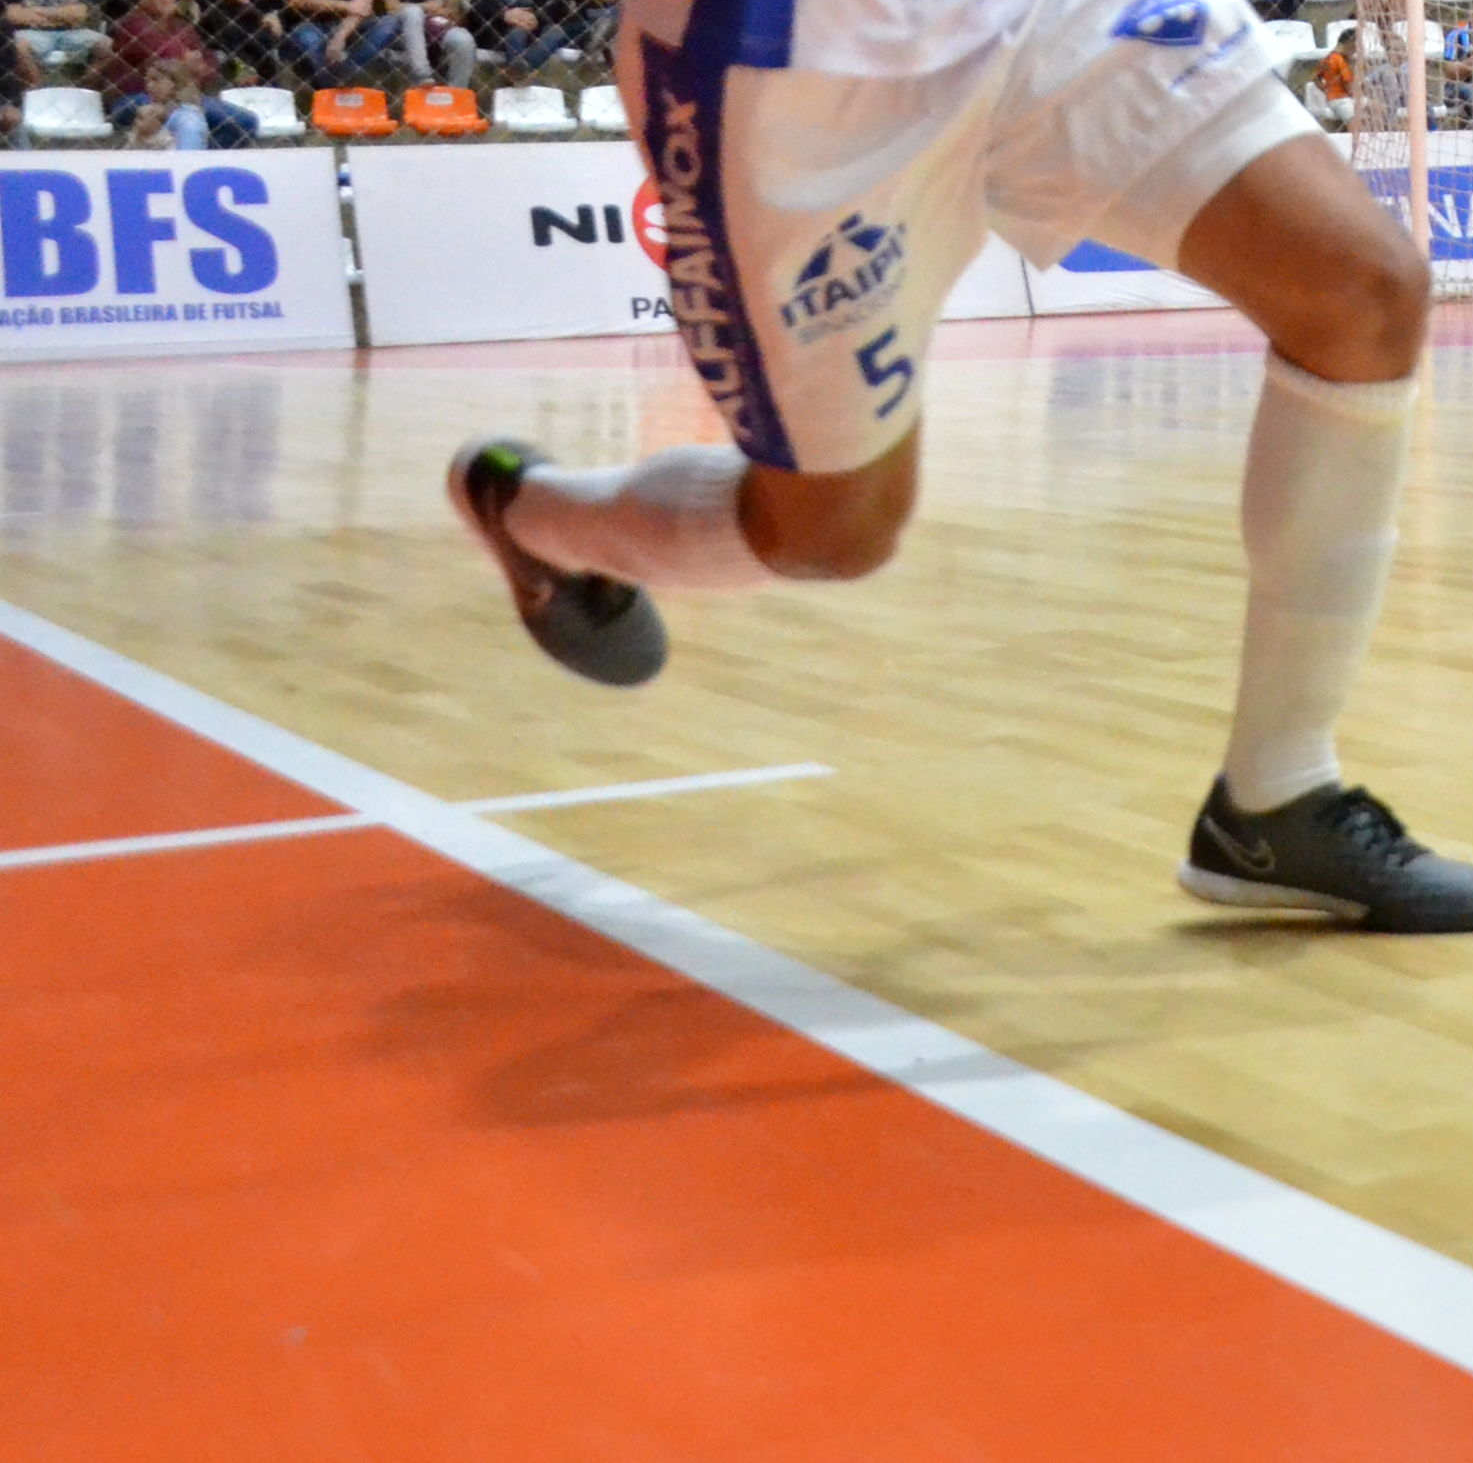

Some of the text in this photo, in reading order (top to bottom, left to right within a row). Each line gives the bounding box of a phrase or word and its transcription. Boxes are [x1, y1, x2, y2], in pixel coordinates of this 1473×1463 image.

[0, 166, 280, 298] BFS
[60, 303, 179, 325] BRASILEIRA
[183, 303, 207, 321] DE
[212, 301, 286, 321] FUTSAL
[855, 325, 914, 420] 5
